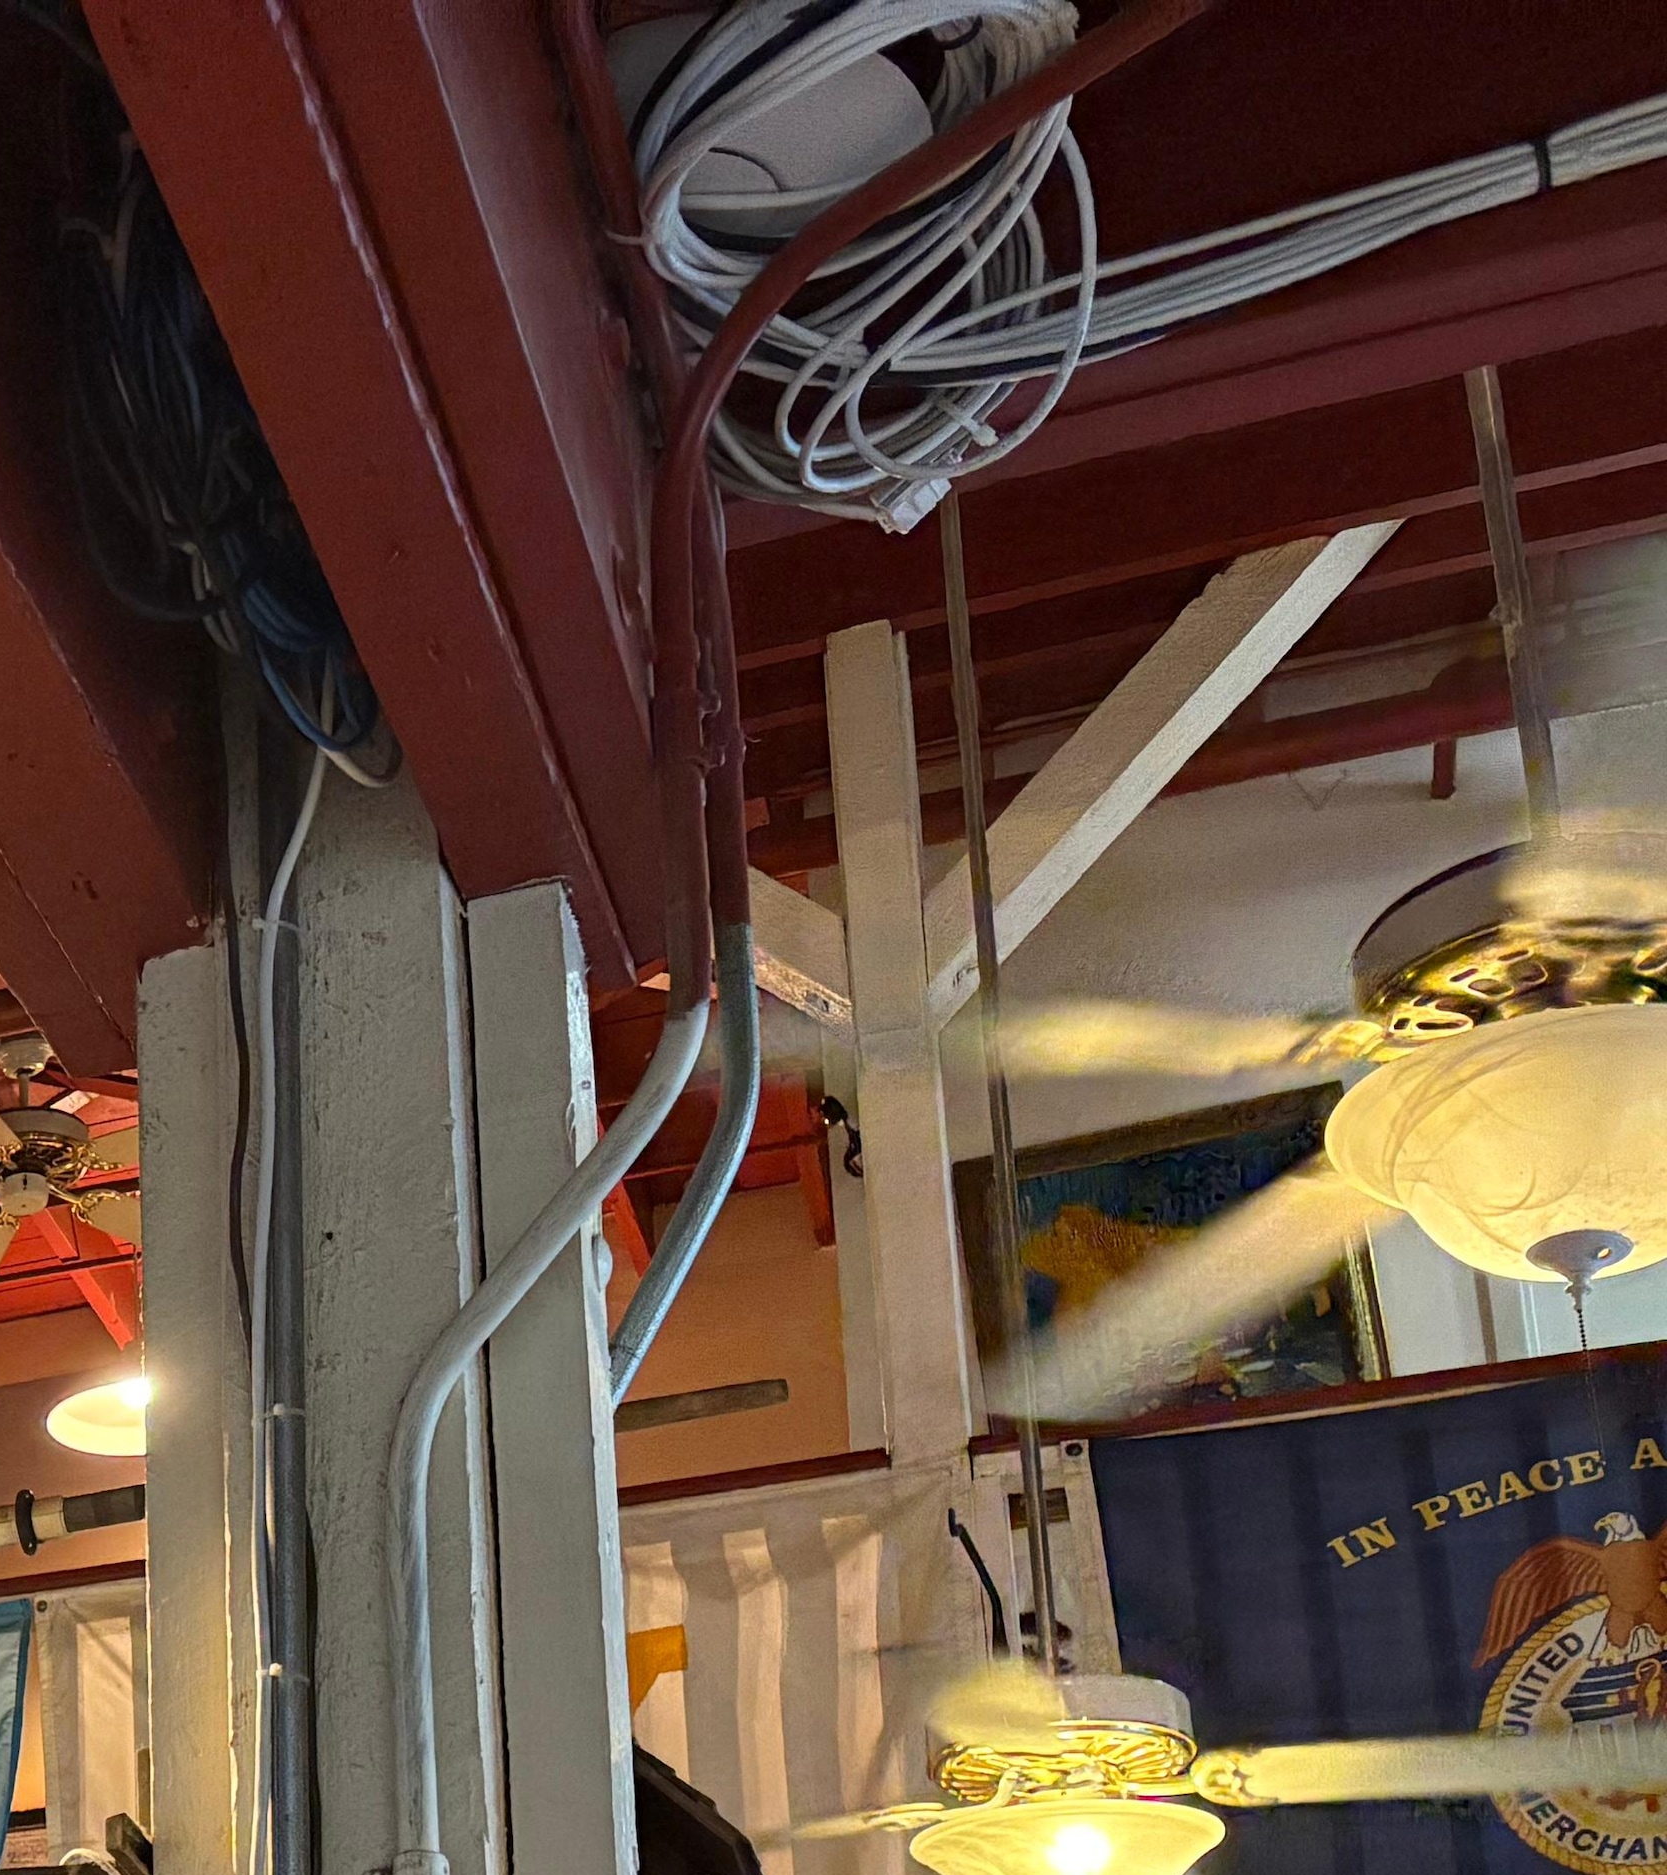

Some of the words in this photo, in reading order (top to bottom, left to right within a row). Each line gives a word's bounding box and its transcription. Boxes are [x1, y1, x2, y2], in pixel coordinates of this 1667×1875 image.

[1327, 1517, 1398, 1567] IN
[1413, 1449, 1606, 1532] PEACE
[1502, 1632, 1586, 1736] UNITED
